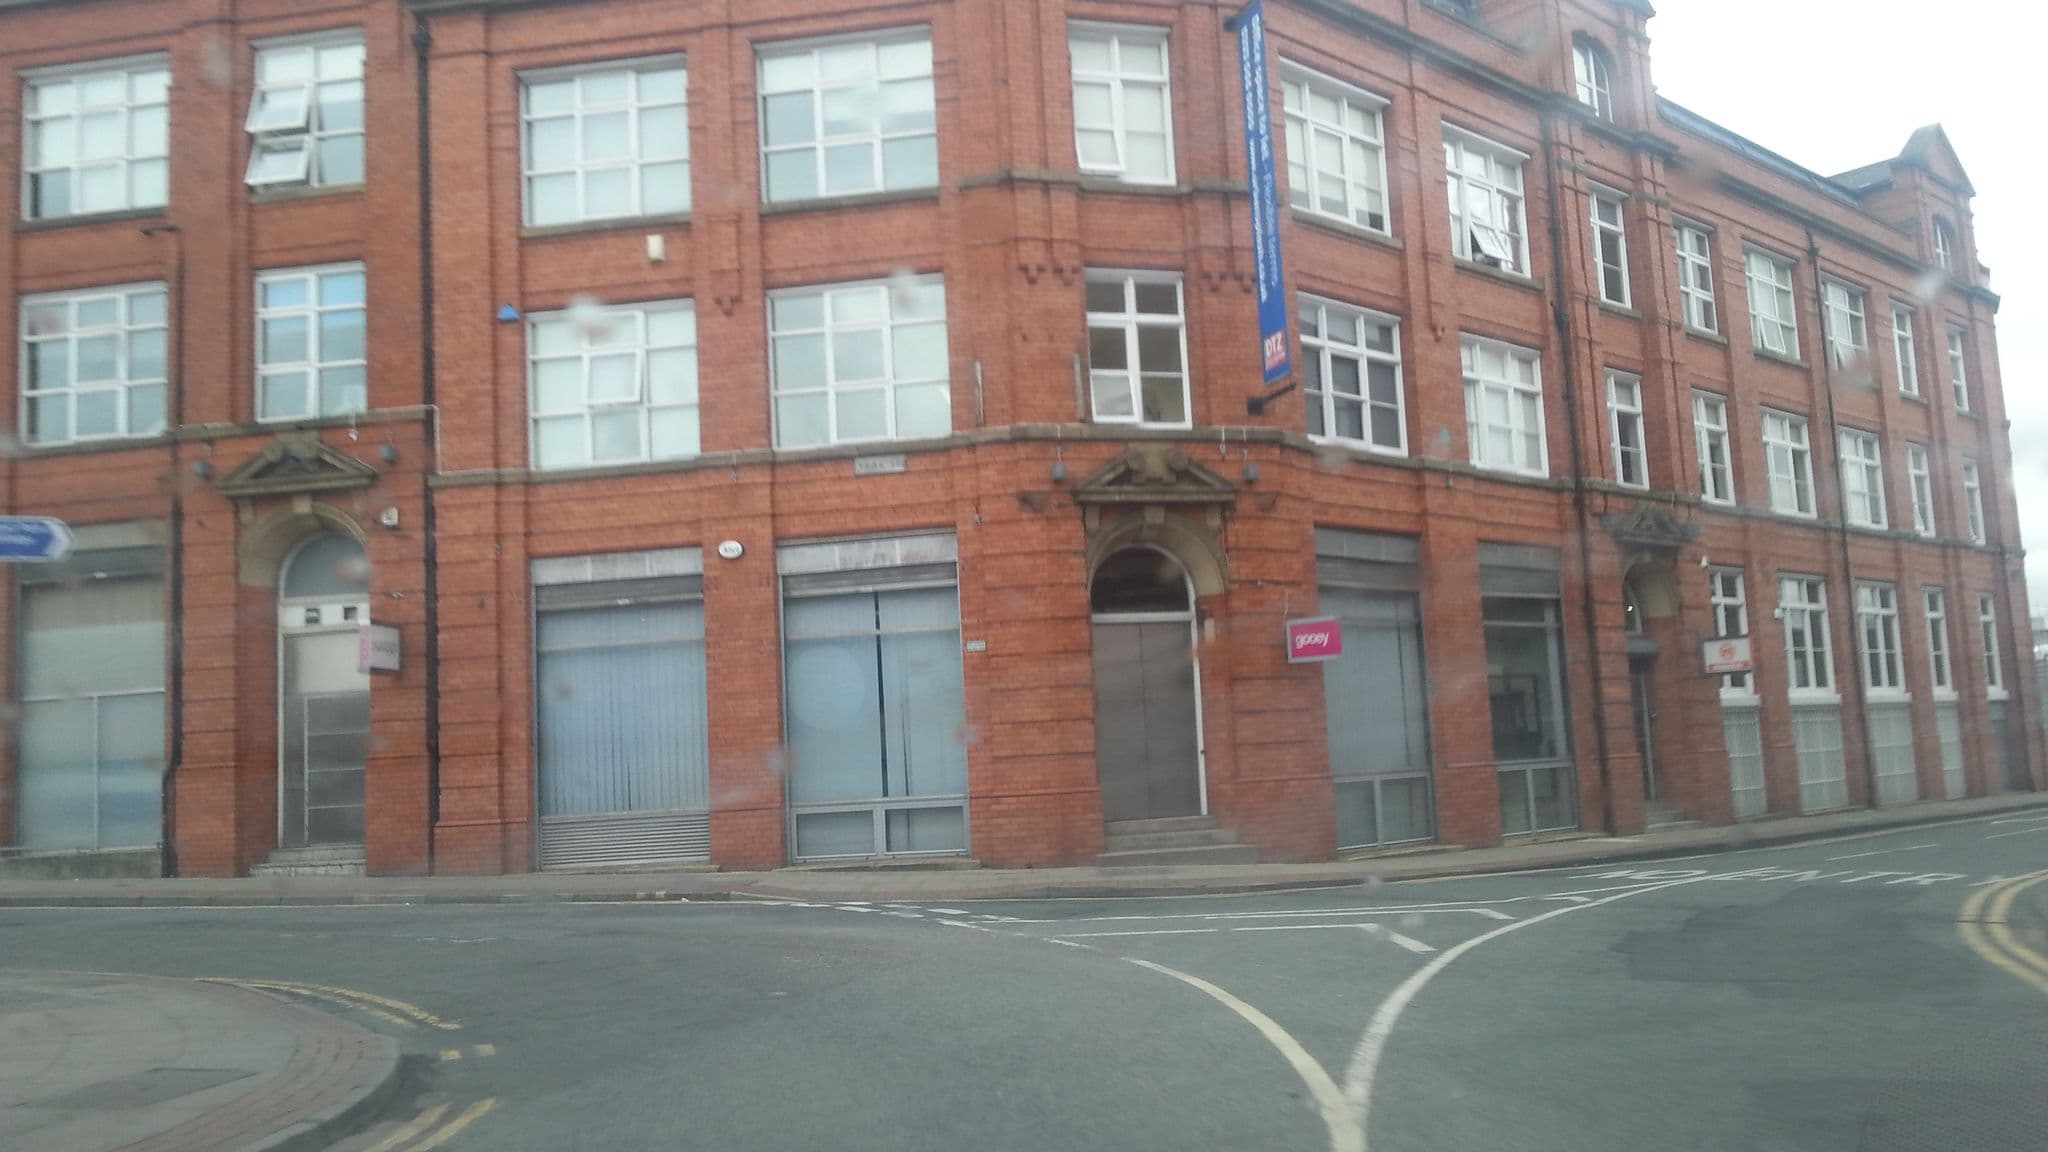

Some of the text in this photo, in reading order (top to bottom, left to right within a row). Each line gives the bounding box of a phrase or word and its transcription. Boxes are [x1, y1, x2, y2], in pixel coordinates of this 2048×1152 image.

[1264, 332, 1284, 358] DTZ
[1296, 632, 1329, 649] gooey
[1569, 869, 1708, 880] NO
